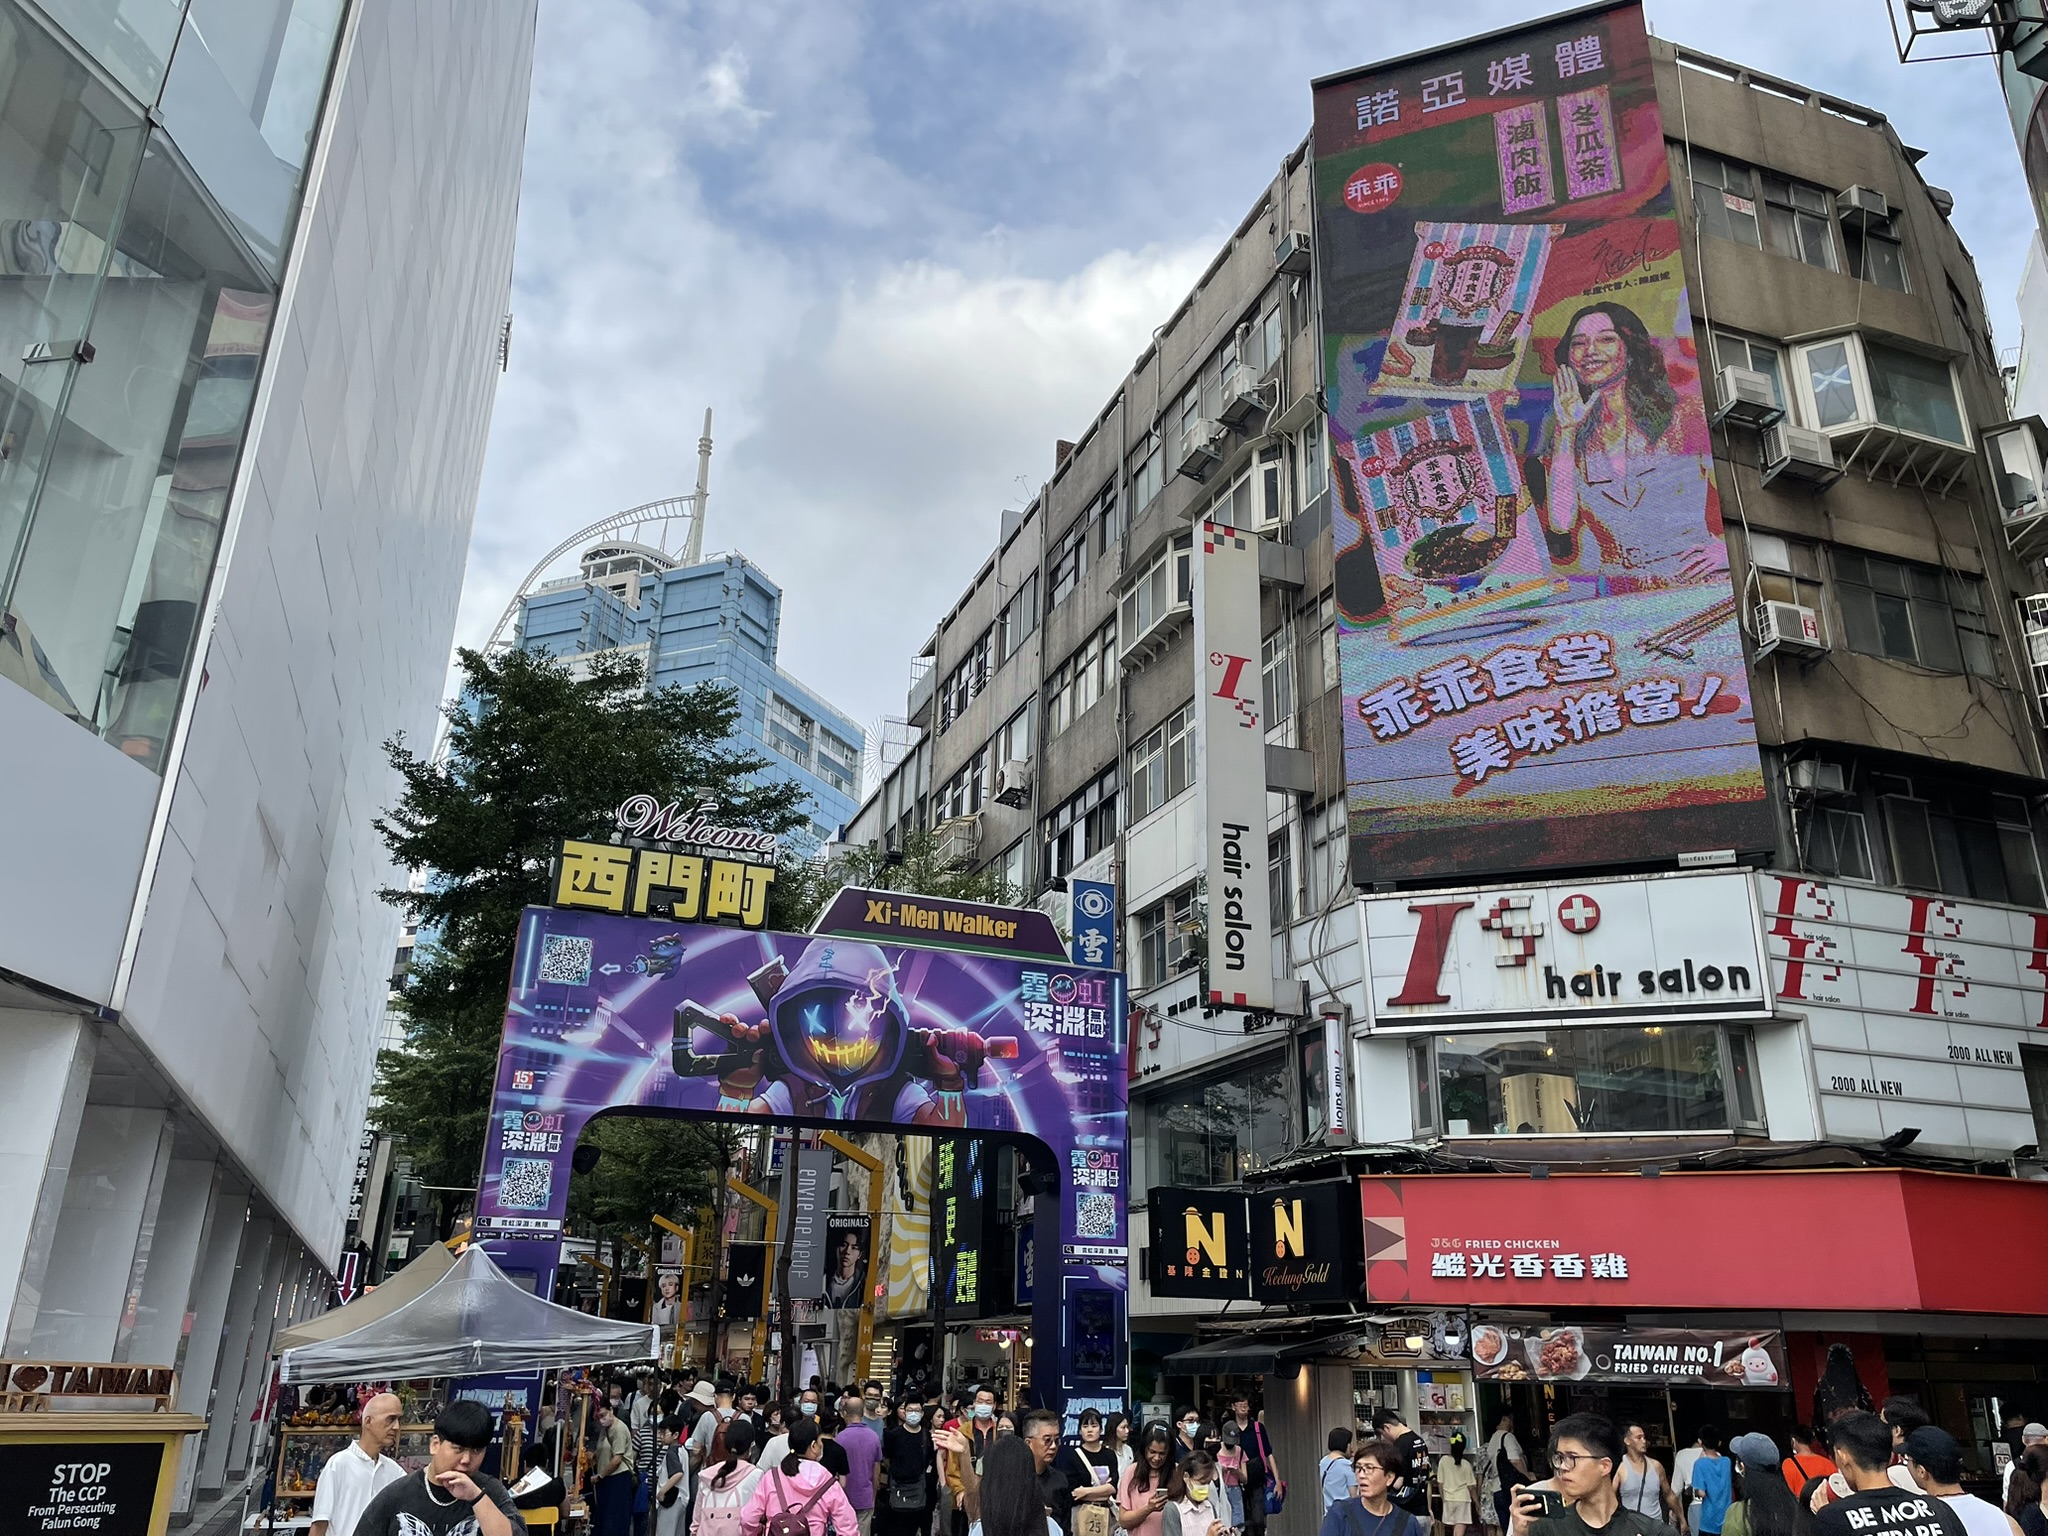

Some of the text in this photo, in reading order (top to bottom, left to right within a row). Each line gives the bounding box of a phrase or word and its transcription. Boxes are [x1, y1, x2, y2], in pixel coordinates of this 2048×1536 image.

[1356, 35, 1604, 131] 諾亞媒體
[1571, 103, 1606, 182] 冬瓜茶
[1507, 118, 1542, 198] 滷肉飯
[1347, 172, 1398, 203] 乖乖
[1362, 634, 1615, 739] 乖乖食堂
[619, 795, 776, 850] Welcome
[556, 840, 775, 926] 西門町
[1222, 822, 1252, 970] hair salon
[863, 900, 1017, 939] Xi-Men Walker
[1545, 959, 1750, 999] hair salon
[1024, 1002, 1085, 1037] 深淵
[1948, 1045, 2013, 1065] 2000 ALL NEW
[1831, 1076, 1902, 1096] 2000 ALL NEW
[502, 1131, 546, 1152] 深淵
[830, 1218, 869, 1228] ORIGINALS
[1431, 1238, 1560, 1249] J&G FRIED CHICKEN
[657, 1267, 683, 1275] ORIGINALS
[1431, 1252, 1629, 1278] 繼光香香雞
[1613, 1340, 1723, 1367] TAIWAN NO.1
[50, 1366, 173, 1395] TAIWAN
[1614, 1363, 1704, 1375] FRIED CHICKEN
[52, 1463, 111, 1485] STOP
[49, 1486, 106, 1503] The CCP
[28, 1502, 116, 1517] From Persecuting
[41, 1517, 101, 1530] Falun Gong
[1845, 1507, 1878, 1530] BE
[1880, 1499, 1936, 1524] MOR
